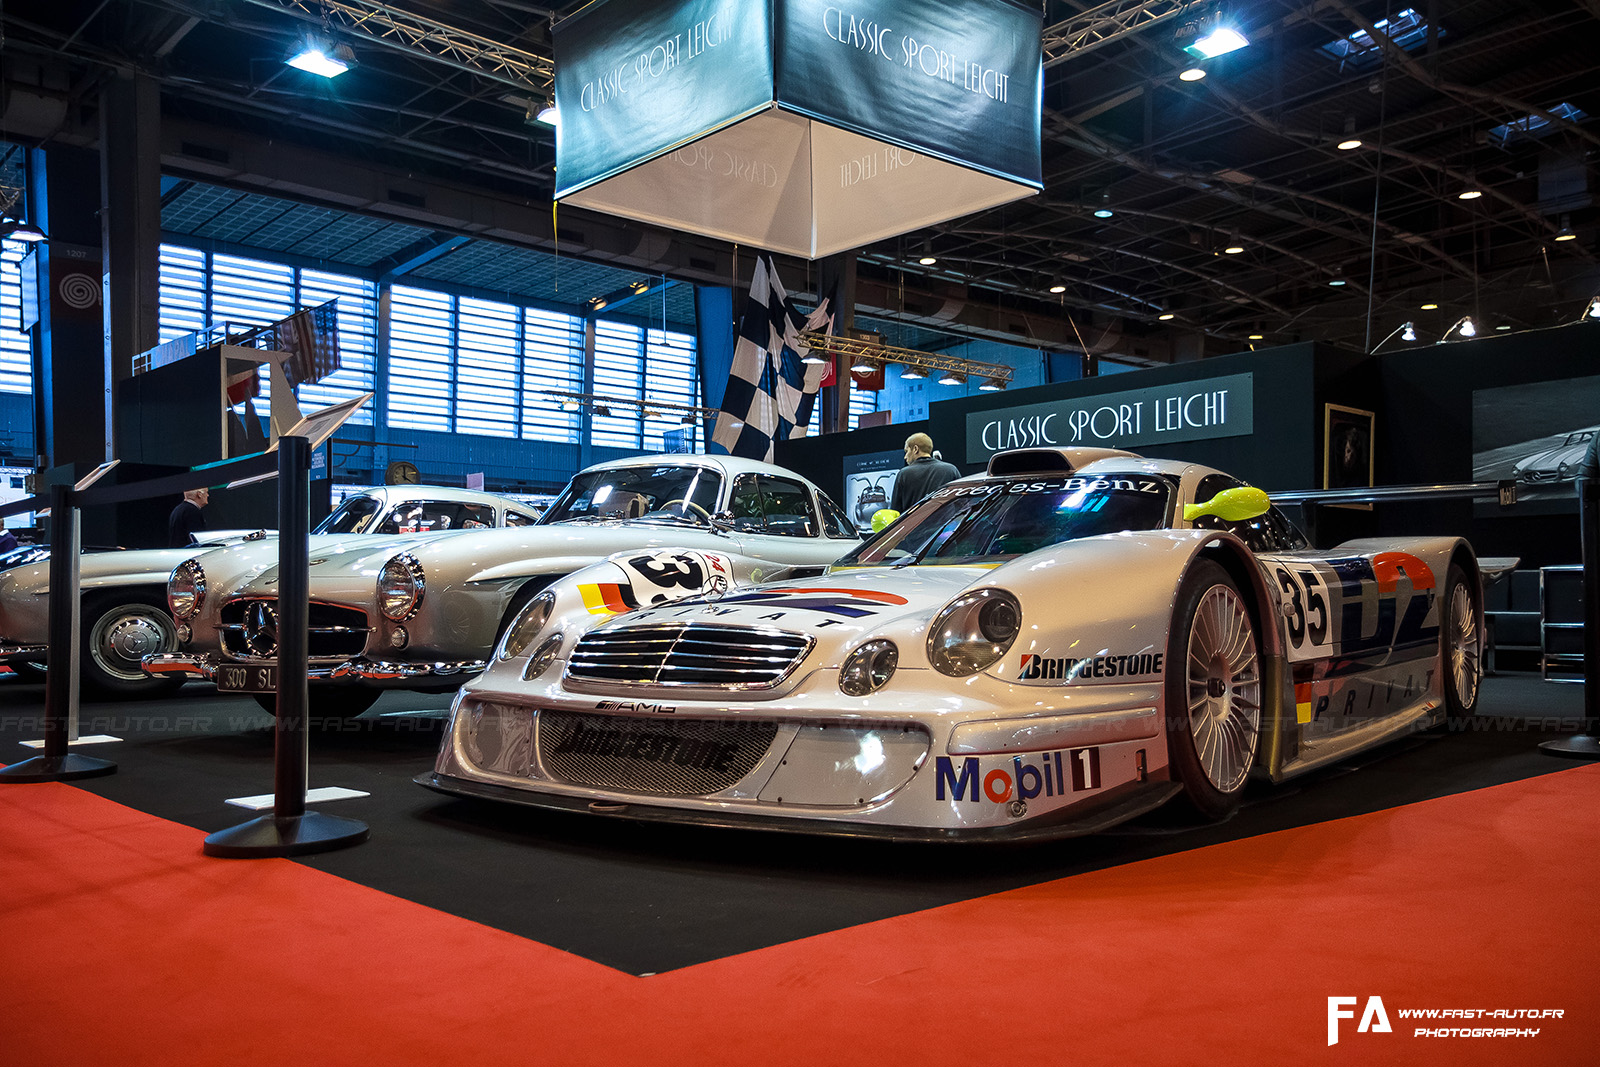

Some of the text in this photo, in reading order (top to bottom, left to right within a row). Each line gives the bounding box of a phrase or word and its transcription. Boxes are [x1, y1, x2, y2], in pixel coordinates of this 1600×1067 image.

[581, 6, 733, 112] CLASSIC SPORT LEICHT
[823, 6, 1009, 104] CLASSIC SPORT LEICHT
[66, 249, 87, 258] 1207
[981, 390, 1228, 451] CLASSIC SPORT LEICHT
[925, 477, 1159, 499] ercedes-Benz
[1275, 567, 1328, 650] 35
[225, 668, 276, 689] 300 SL
[1017, 653, 1164, 680] BRIDGESTONE
[616, 702, 677, 714] AMG
[1314, 669, 1435, 721] PRIVAT
[935, 751, 1065, 804] Mobil
